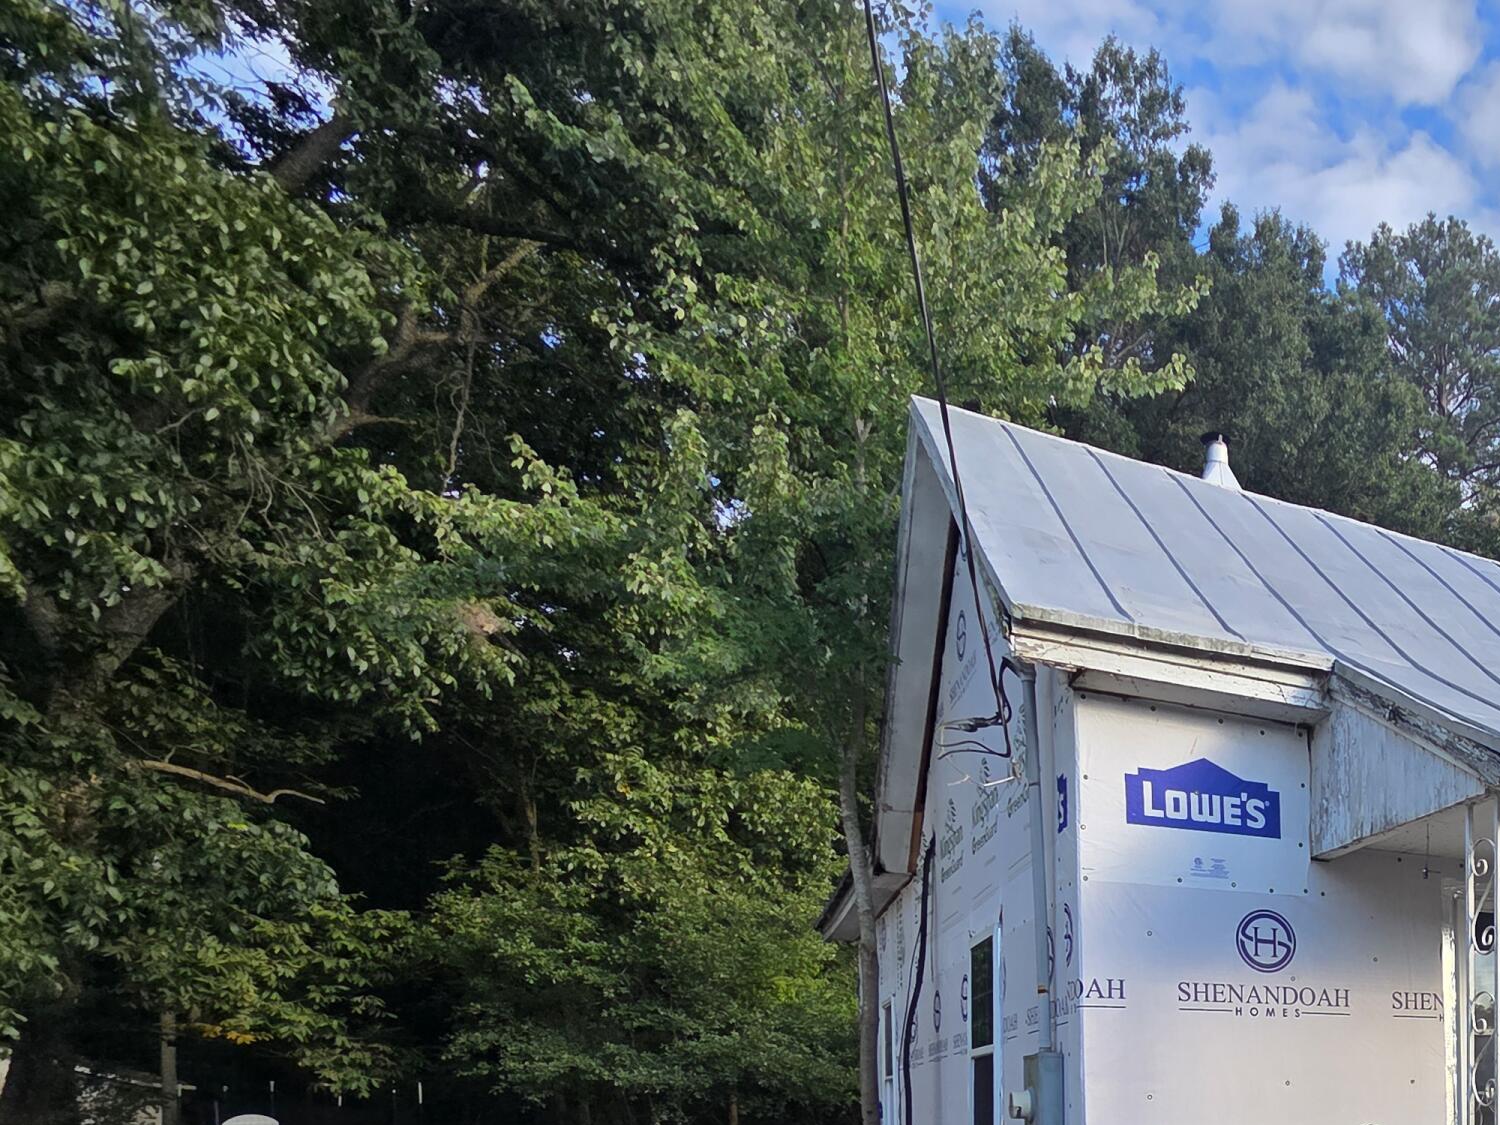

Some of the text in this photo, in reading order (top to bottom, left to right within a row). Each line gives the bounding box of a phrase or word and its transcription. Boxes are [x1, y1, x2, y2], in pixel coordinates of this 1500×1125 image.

[1142, 780, 1266, 829] LOWE'S
[1177, 982, 1351, 1008] SHENANDOAH
[1235, 1007, 1301, 1018] HOMES
